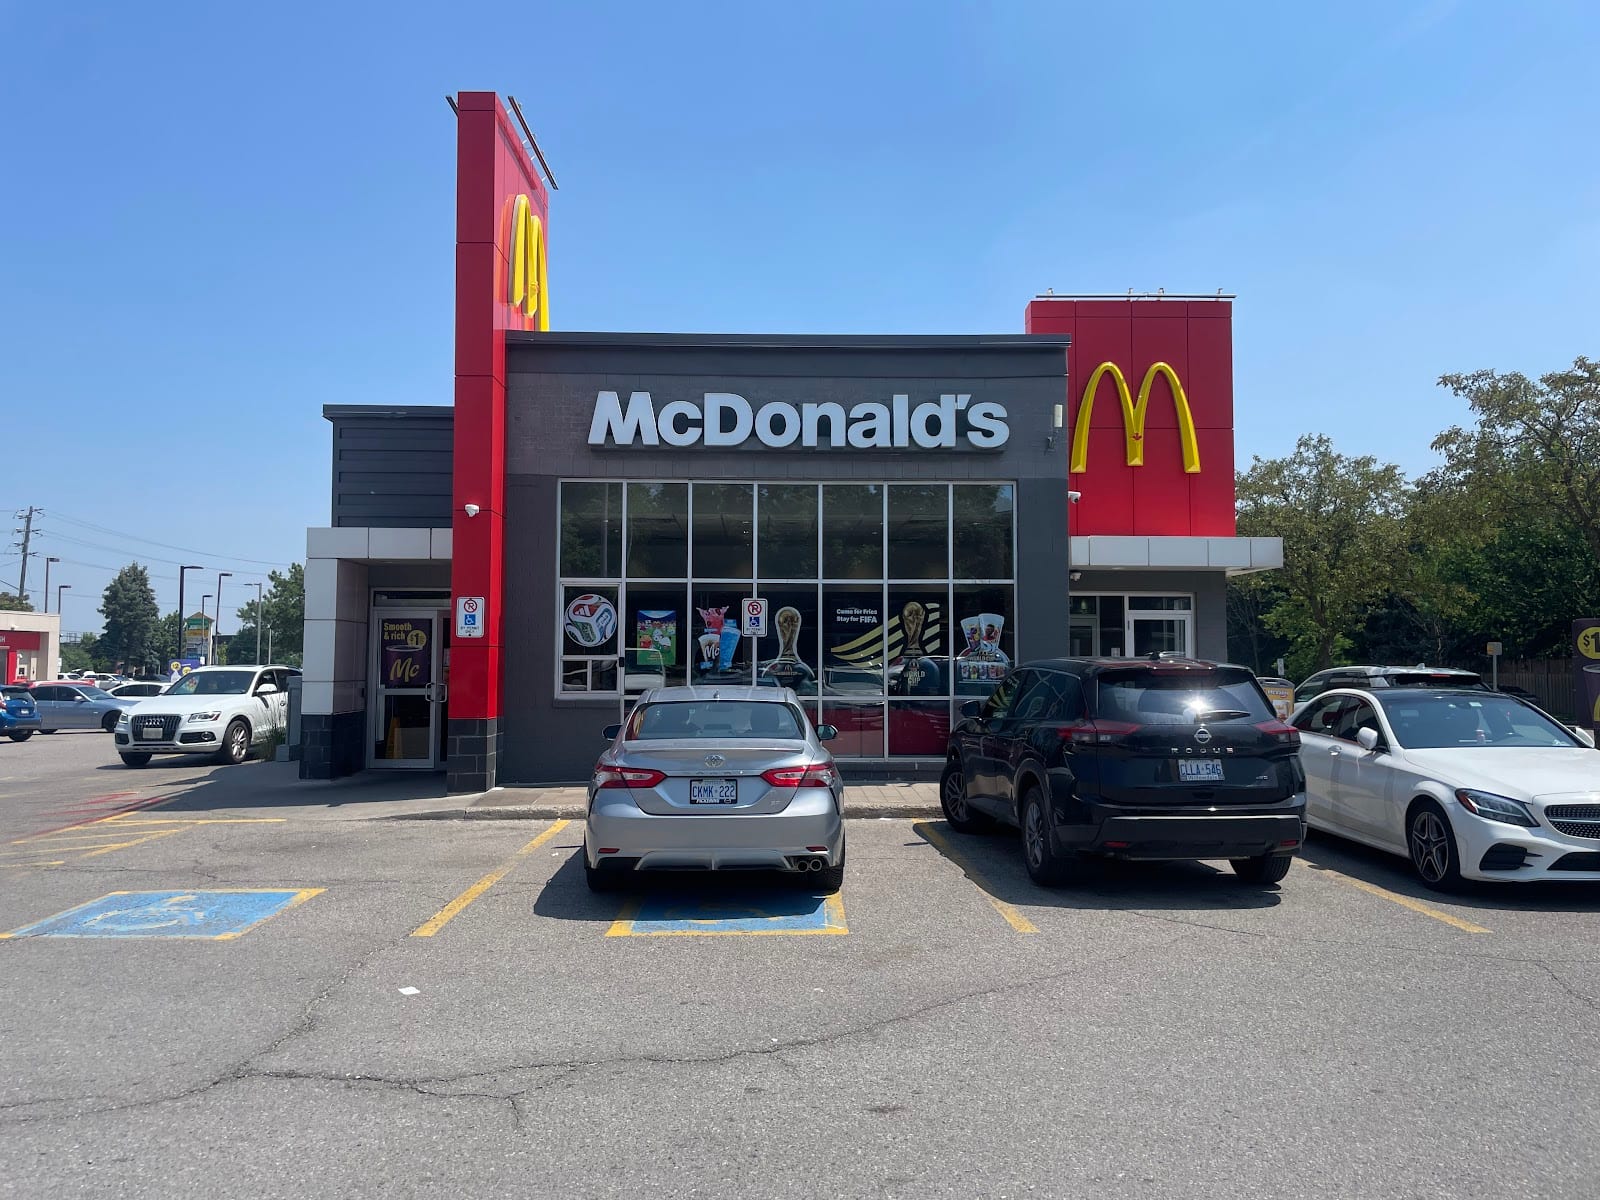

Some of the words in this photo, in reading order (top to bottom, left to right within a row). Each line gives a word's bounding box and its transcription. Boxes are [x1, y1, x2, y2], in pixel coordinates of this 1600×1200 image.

[587, 390, 1010, 448] McDonald's
[383, 622, 412, 631] Smooth
[383, 632, 389, 640] &
[391, 631, 405, 640] rich
